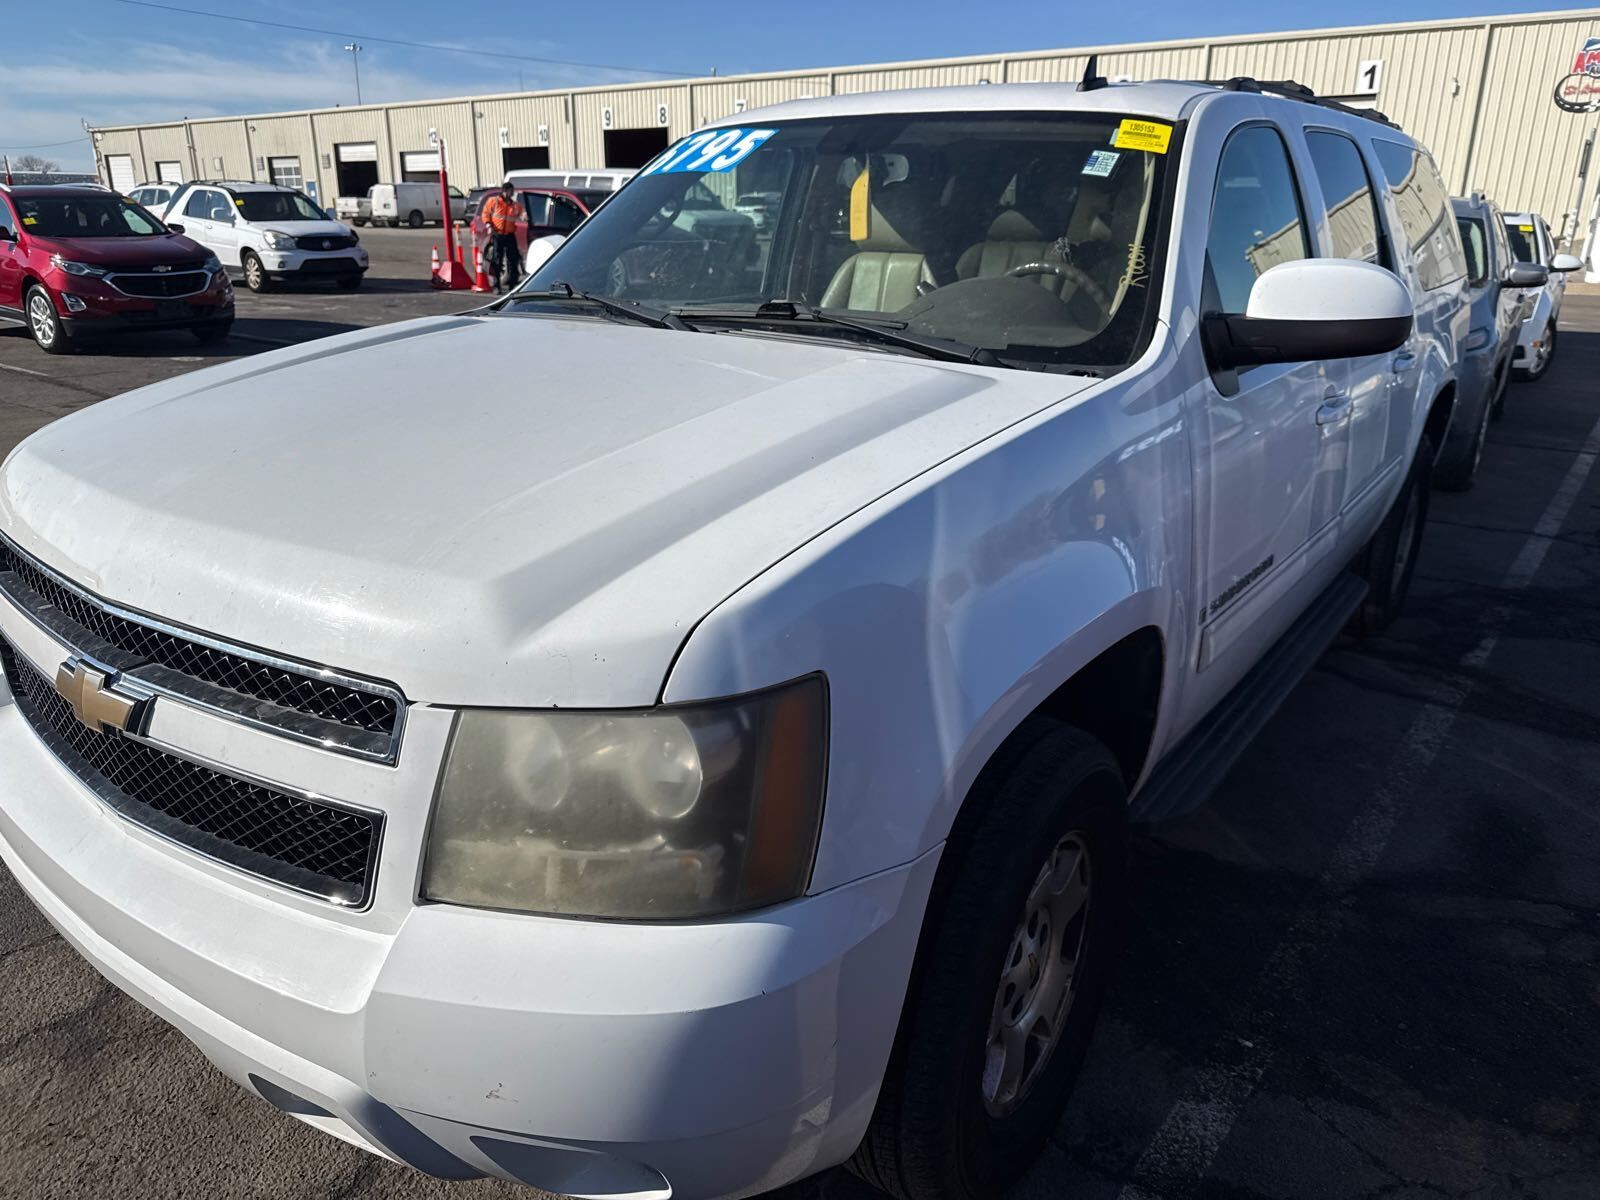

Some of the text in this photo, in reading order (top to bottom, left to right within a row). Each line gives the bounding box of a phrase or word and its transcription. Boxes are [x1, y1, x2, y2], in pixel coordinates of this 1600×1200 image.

[1364, 64, 1377, 90] 1
[604, 110, 612, 127] 9
[659, 106, 667, 124] 8
